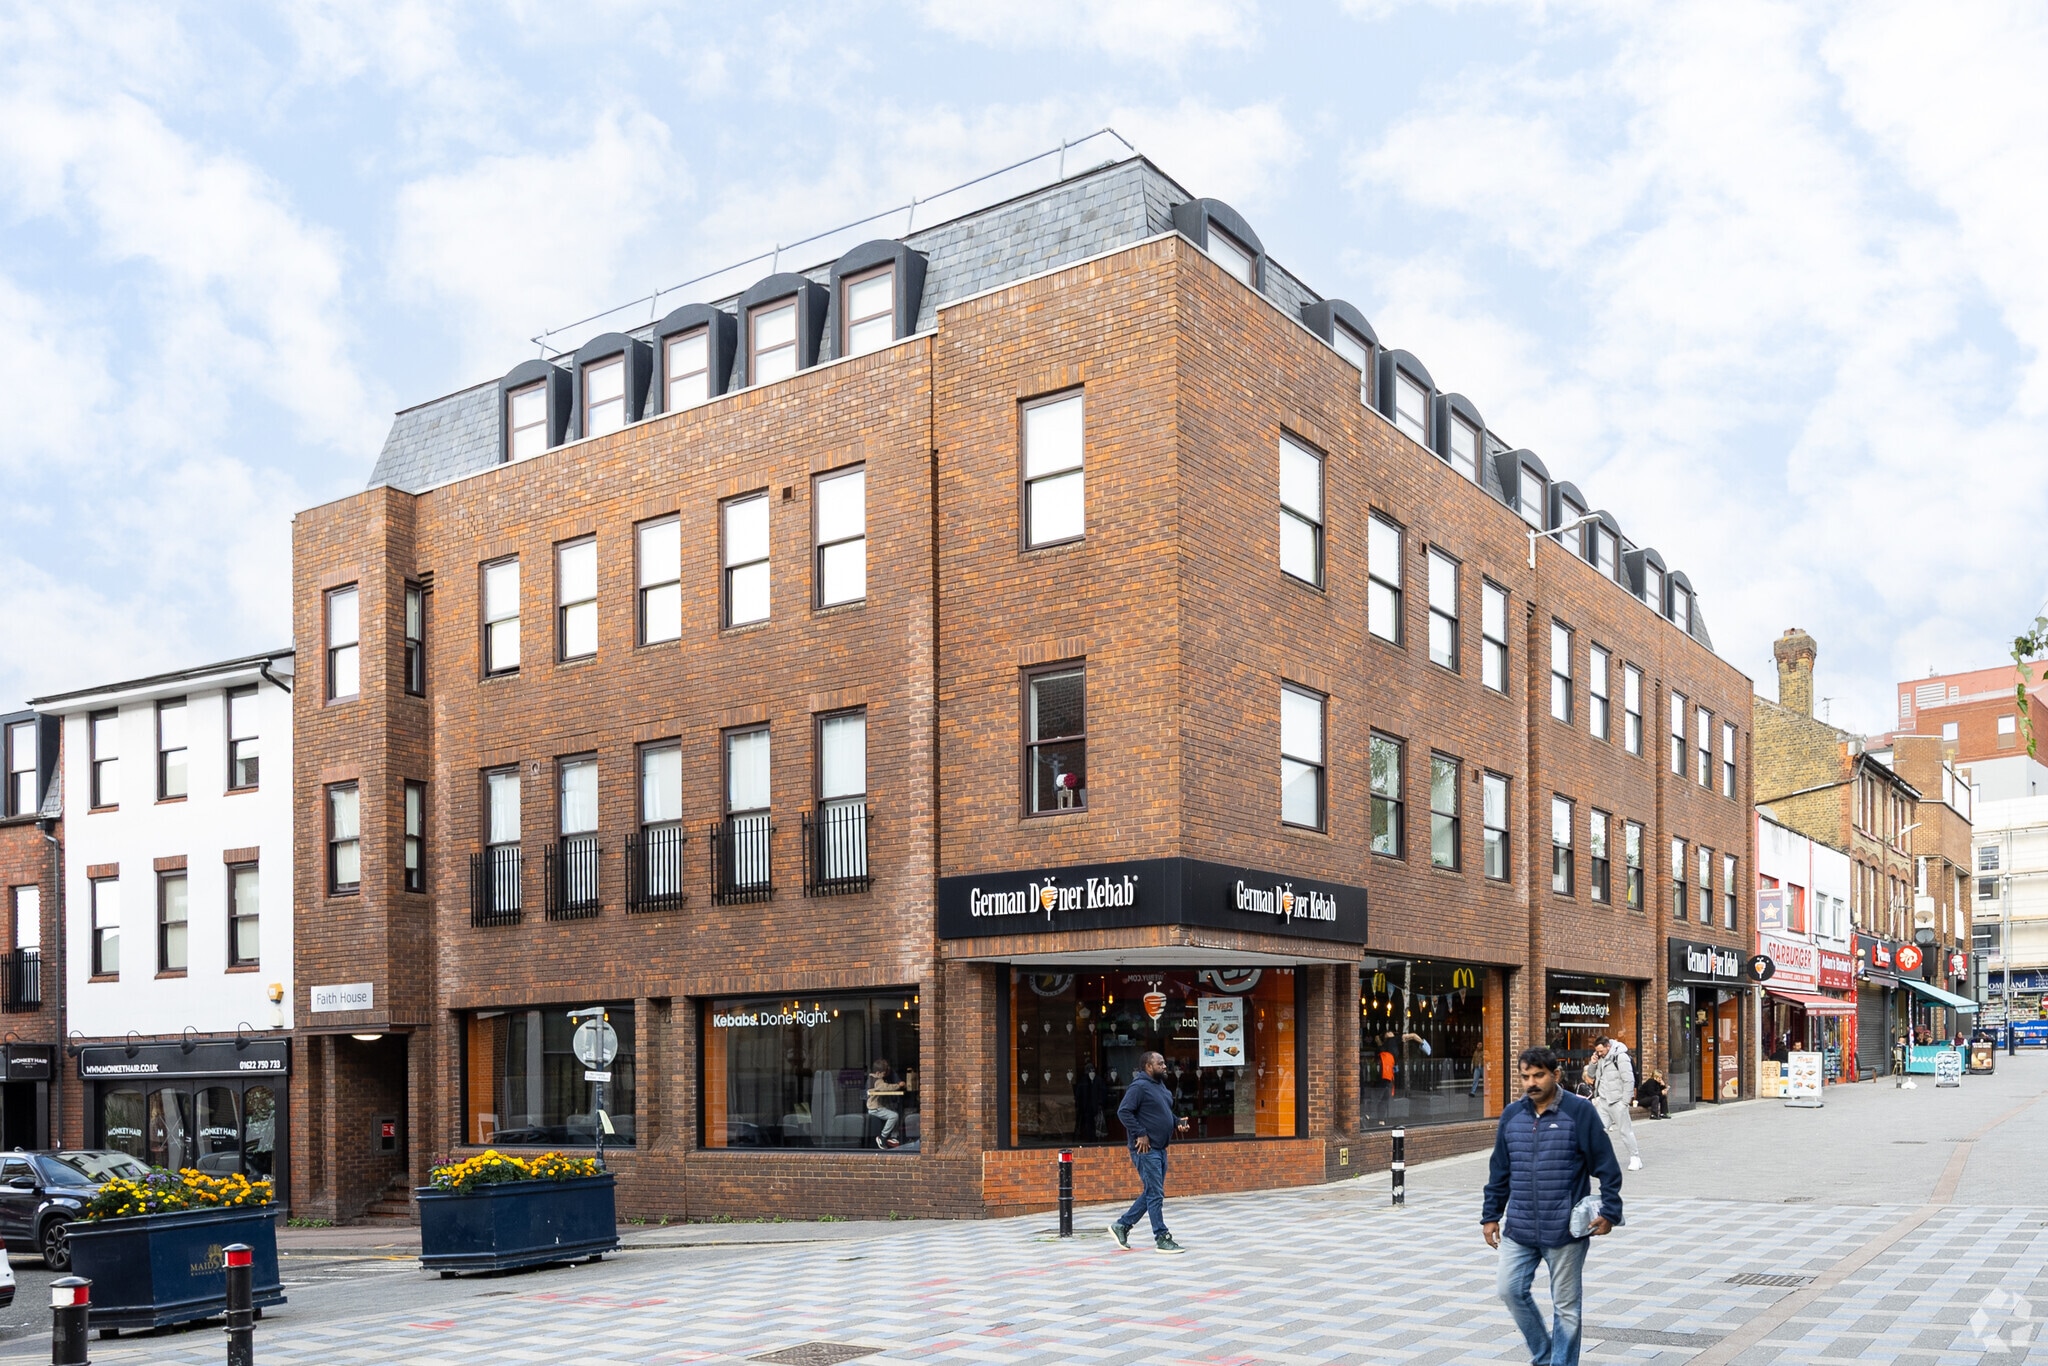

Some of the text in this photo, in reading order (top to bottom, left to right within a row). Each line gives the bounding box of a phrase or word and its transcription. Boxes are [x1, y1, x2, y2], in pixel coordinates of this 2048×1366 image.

[970, 888, 1027, 917] German
[1086, 875, 1134, 909] Kebab
[1236, 880, 1275, 914] German
[1309, 891, 1336, 921] Kebab
[1687, 945, 1707, 973] German
[1768, 942, 1812, 968] STARBURGER
[316, 992, 367, 1005] Faith House
[1208, 1001, 1234, 1011] FIVER
[1581, 1002, 1596, 1015] Done
[713, 1010, 831, 1027] Kebabs. Done Right.
[86, 1063, 159, 1073] WWW.MONKEYHAIR.CO.UK
[269, 1059, 281, 1069] 733
[107, 1127, 142, 1137] MONKEY HAIR
[200, 1127, 238, 1138] MONKEY HAIR
